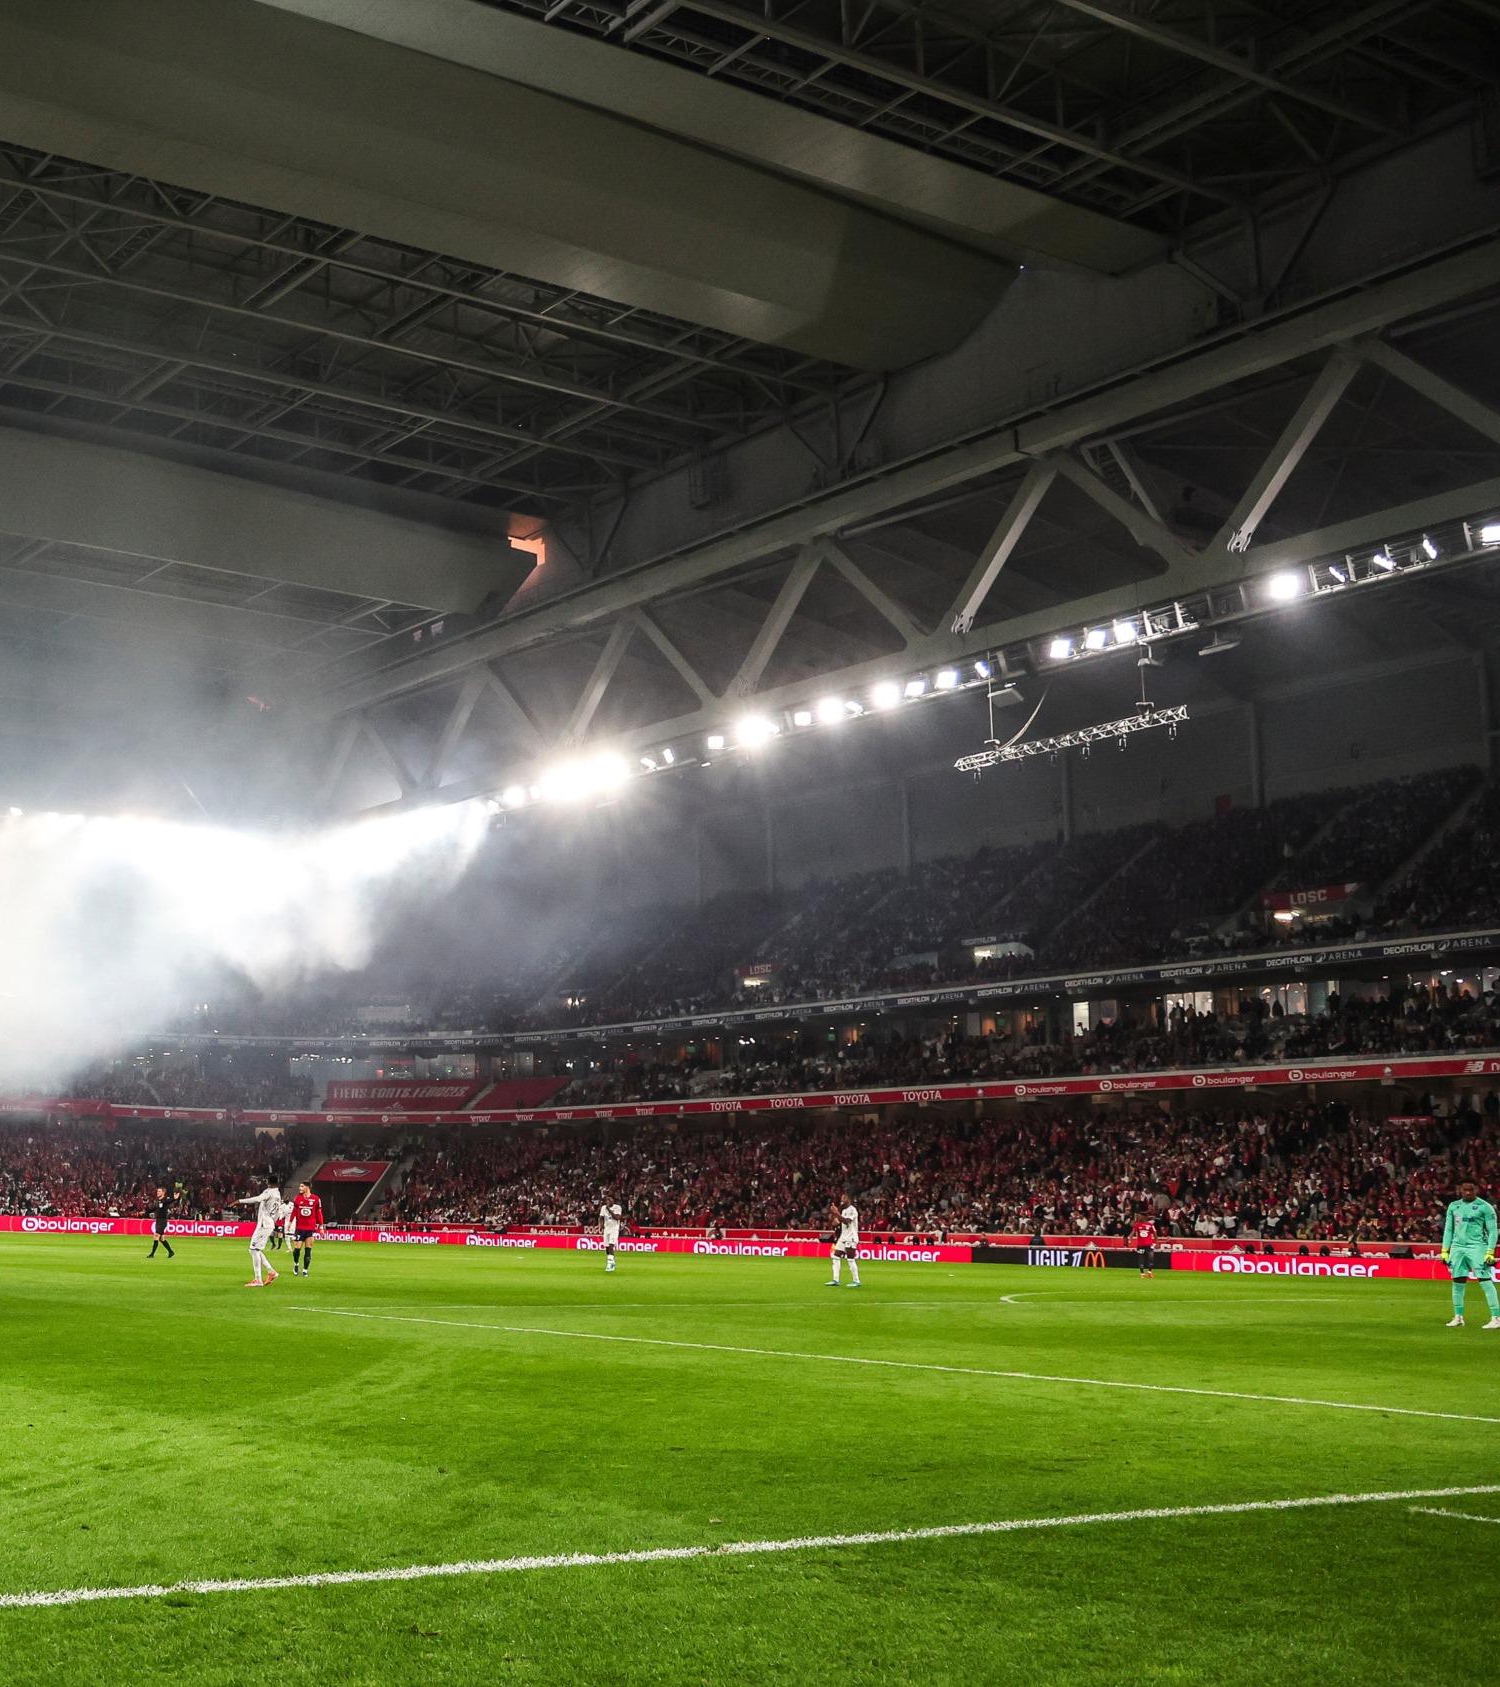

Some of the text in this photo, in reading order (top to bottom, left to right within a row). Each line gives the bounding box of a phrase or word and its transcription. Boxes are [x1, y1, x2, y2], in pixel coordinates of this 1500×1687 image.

[1290, 889, 1328, 906] LOSC
[1384, 937, 1492, 956] DECATHLON ARENA
[1266, 949, 1363, 968] DECATHLON ARENA
[1160, 962, 1248, 978] DECATHLON ARENA
[1064, 973, 1145, 988] DECATHLON ARENA
[977, 982, 1051, 997] DECATHLON ARENA
[897, 991, 965, 1006] DECATHLON ARENA
[823, 1003, 854, 1013] DECATHLON
[1207, 1074, 1255, 1086] boulanger
[1305, 1070, 1357, 1081] boulanger
[1027, 1085, 1067, 1095] boulanger
[1113, 1080, 1157, 1090] boulanger
[770, 1097, 804, 1108] TOYOTA
[833, 1094, 871, 1105] TOYOTA
[902, 1090, 942, 1101] TOYOTA
[709, 1101, 742, 1112] TOYOTA
[38, 1218, 114, 1234] boulanger
[168, 1221, 239, 1237] boulanger
[313, 1231, 355, 1243] oulanger
[590, 1238, 658, 1252] bolanger
[707, 1242, 789, 1257] boulanger
[1028, 1250, 1070, 1267] LIGUE
[1240, 1257, 1380, 1278] boulanger
